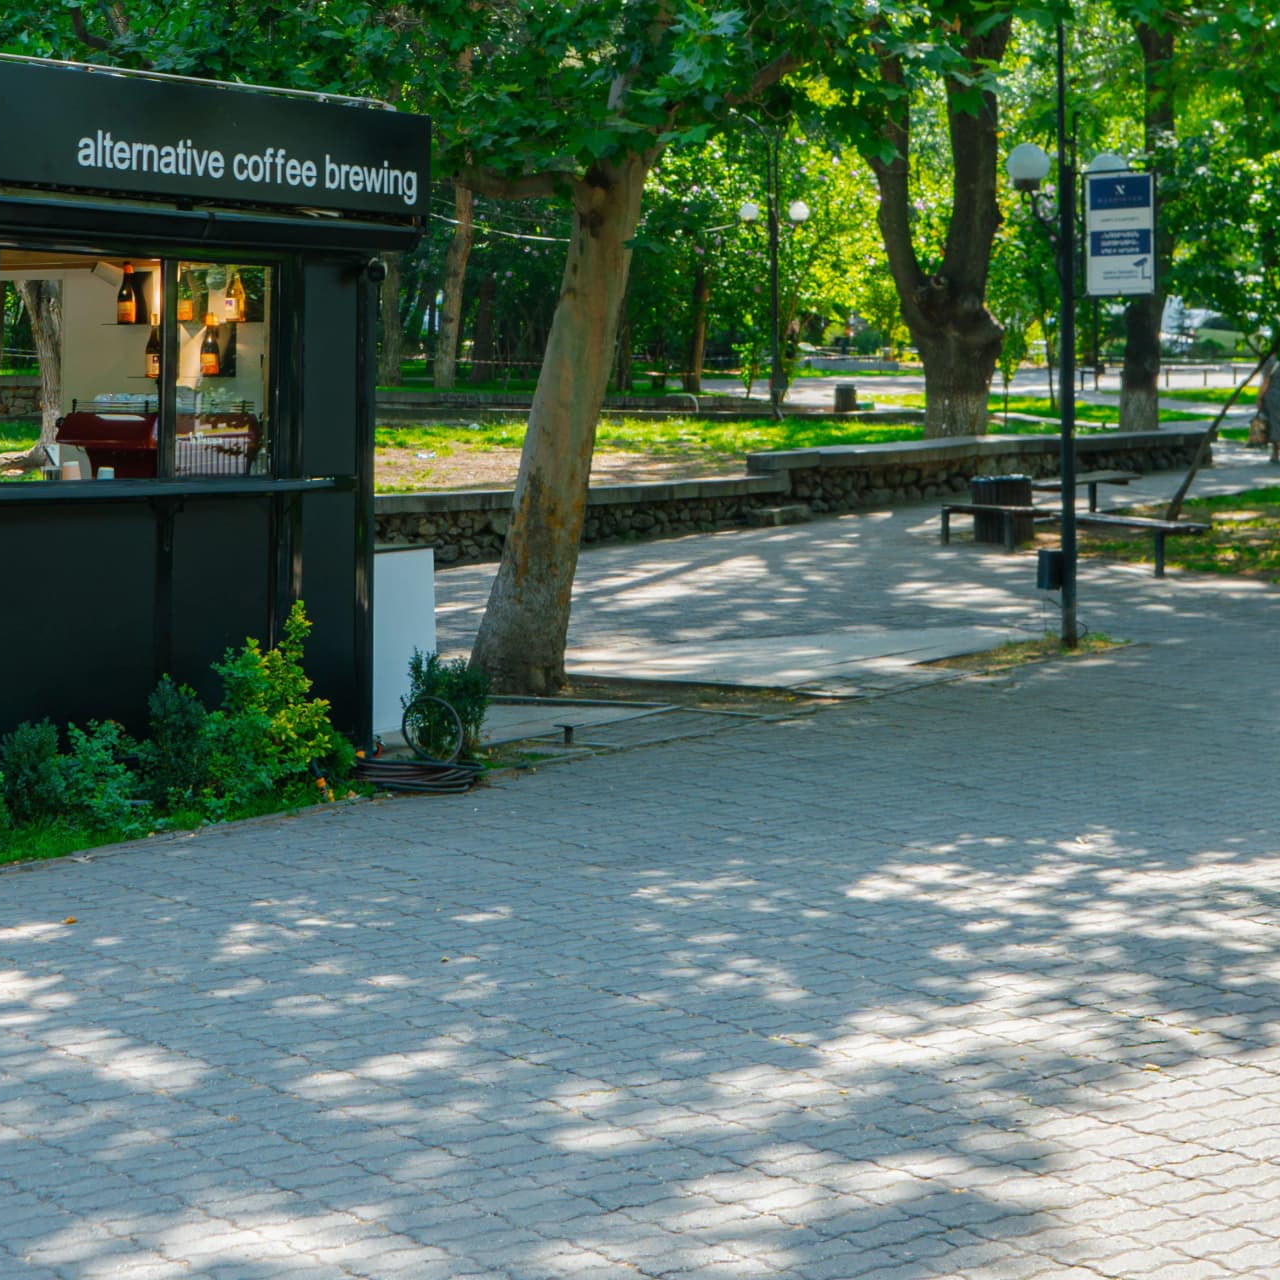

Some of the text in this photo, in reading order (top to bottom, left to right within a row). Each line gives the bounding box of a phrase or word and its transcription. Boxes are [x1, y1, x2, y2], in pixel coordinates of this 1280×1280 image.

[77, 130, 418, 205] alternative coffee brewing
